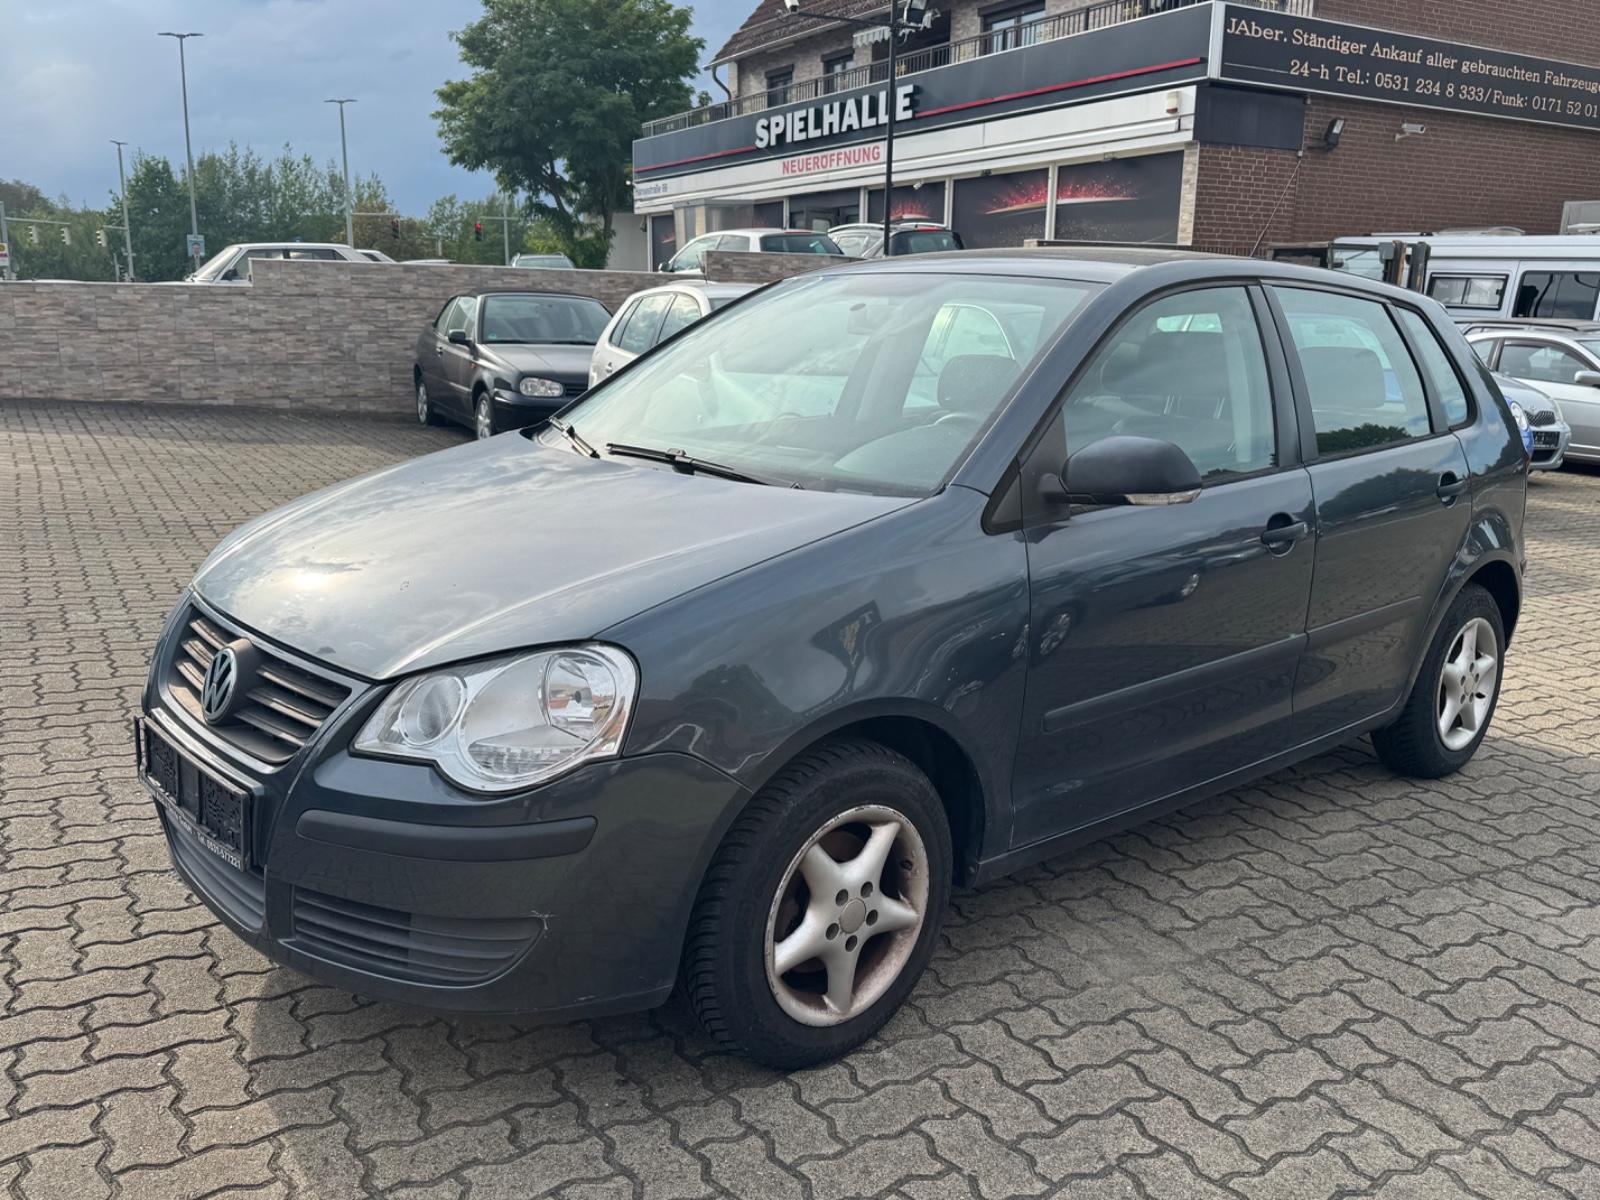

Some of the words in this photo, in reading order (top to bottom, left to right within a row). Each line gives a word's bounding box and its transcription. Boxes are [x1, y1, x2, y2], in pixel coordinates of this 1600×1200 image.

[1292, 28, 1367, 55] Ständiger
[1370, 41, 1423, 64] Ankauf
[1426, 51, 1459, 69] aller
[1461, 60, 1540, 83] gebrauchten
[755, 84, 914, 149] SPIELHALLE
[1290, 59, 1330, 80] 24-h
[1335, 66, 1370, 85] Tel.:
[1375, 72, 1409, 91] 0531
[1416, 78, 1441, 96] 234
[1445, 83, 1455, 98] 8
[1532, 95, 1562, 113] 0171
[1566, 101, 1582, 116] 52
[1584, 104, 1598, 118] 01
[782, 145, 881, 175] NEUERÖFFNUNG
